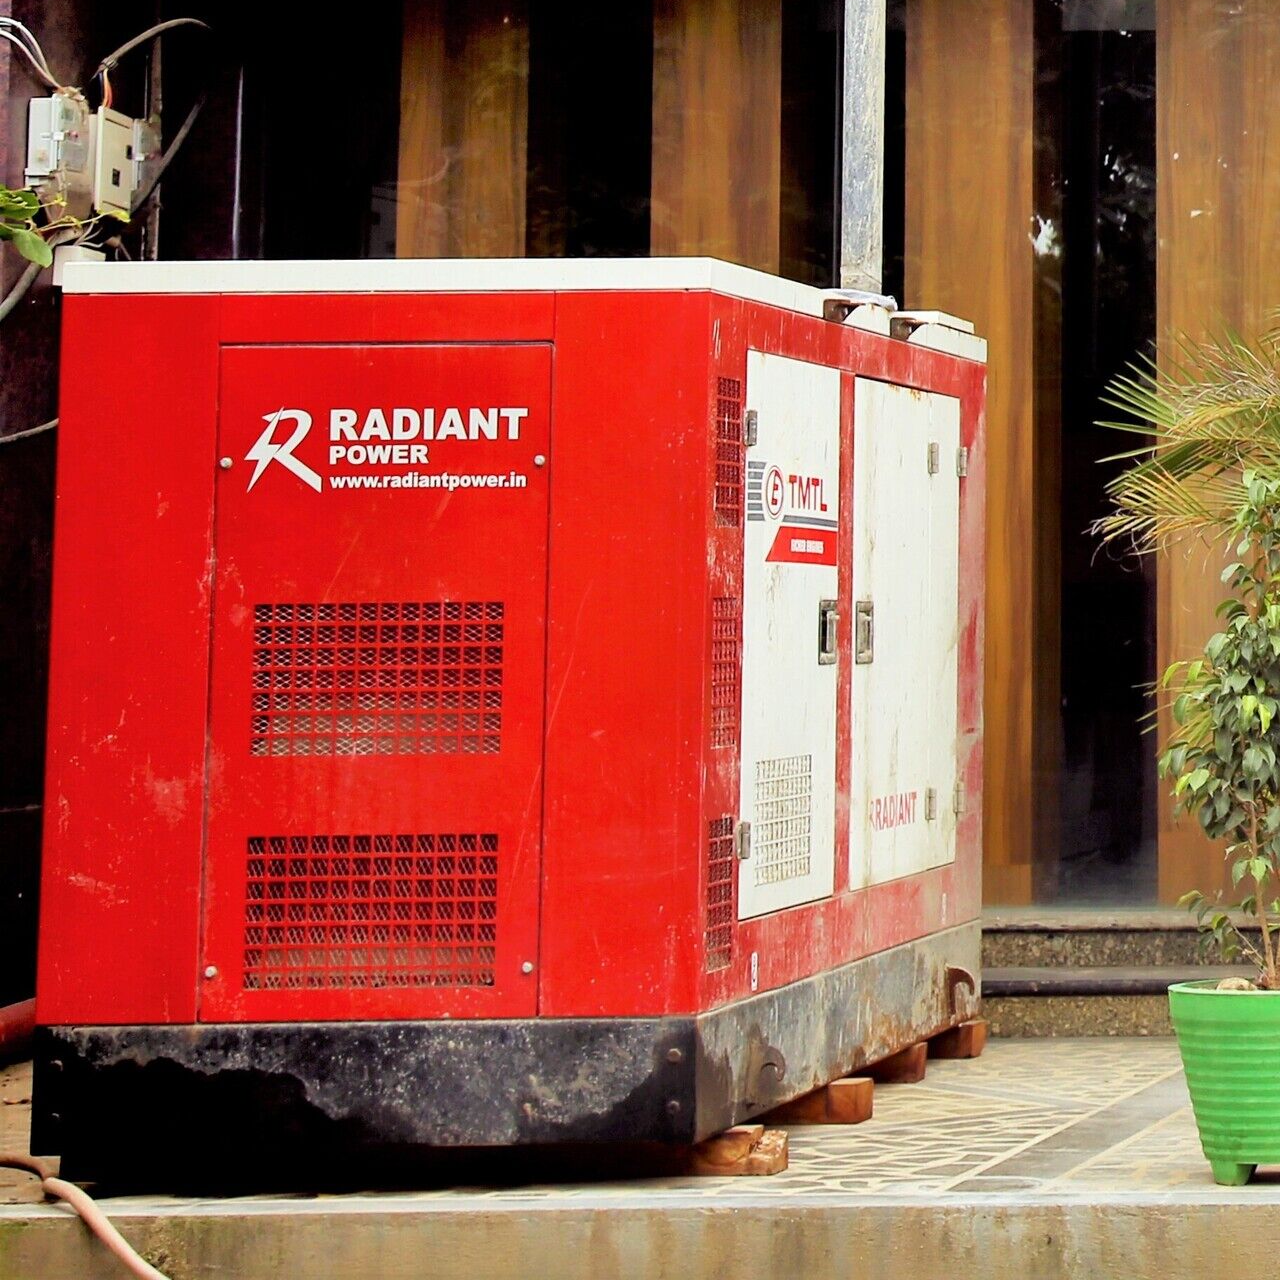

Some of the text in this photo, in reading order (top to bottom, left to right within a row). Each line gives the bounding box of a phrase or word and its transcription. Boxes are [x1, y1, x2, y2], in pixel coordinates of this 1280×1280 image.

[329, 407, 529, 441] RADIANT
[329, 444, 429, 465] POWER
[329, 471, 527, 492] www.radiantpower.in
[788, 474, 828, 512] TMTL
[875, 792, 917, 831] RADIANT
